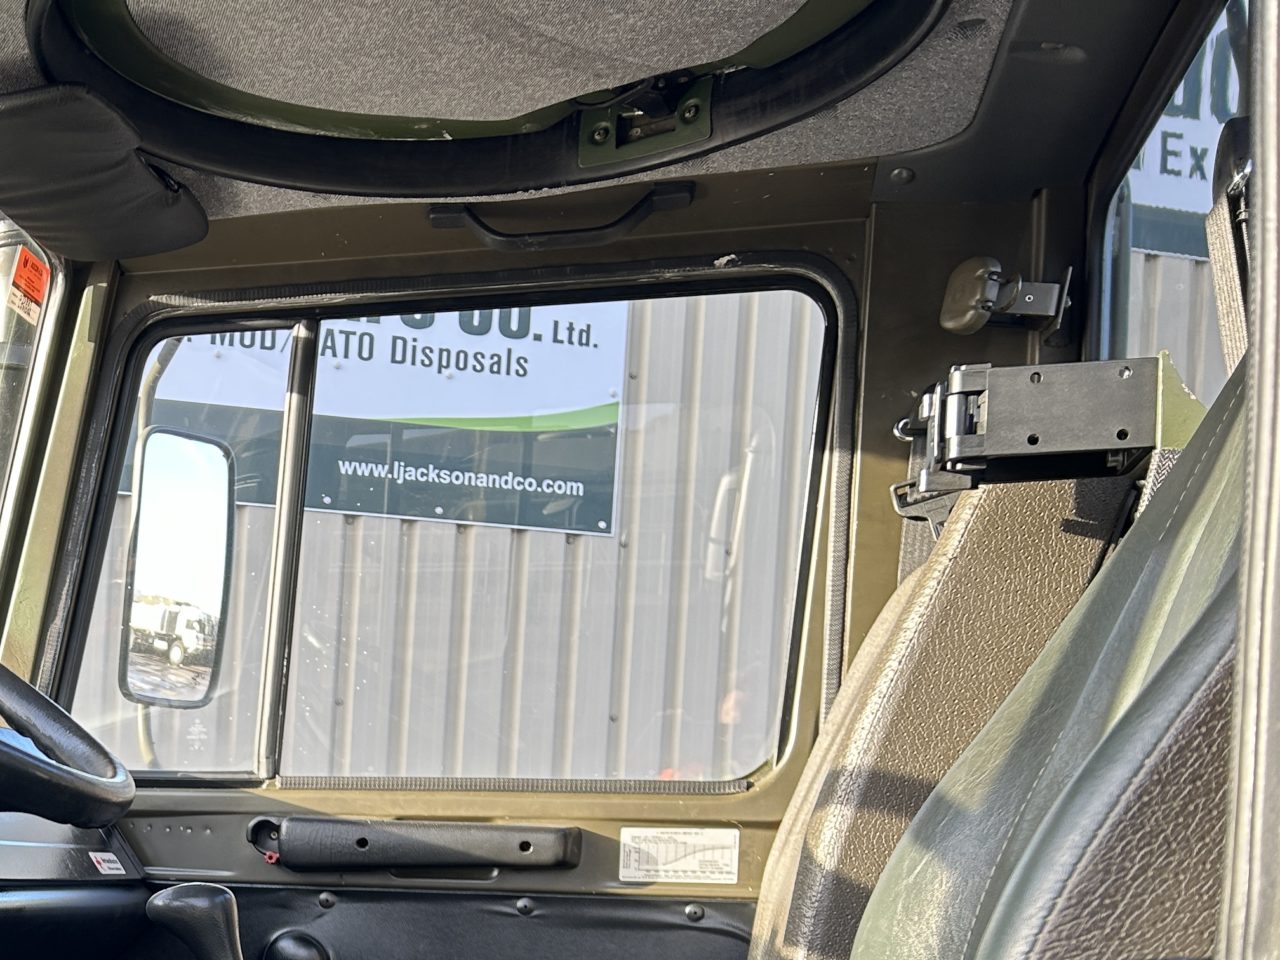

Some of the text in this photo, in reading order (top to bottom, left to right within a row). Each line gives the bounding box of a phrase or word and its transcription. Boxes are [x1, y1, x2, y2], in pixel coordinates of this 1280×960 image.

[551, 320, 599, 348] Ltd.
[390, 335, 529, 378] Disposals
[337, 459, 585, 497] www.ljacksonandco.com
